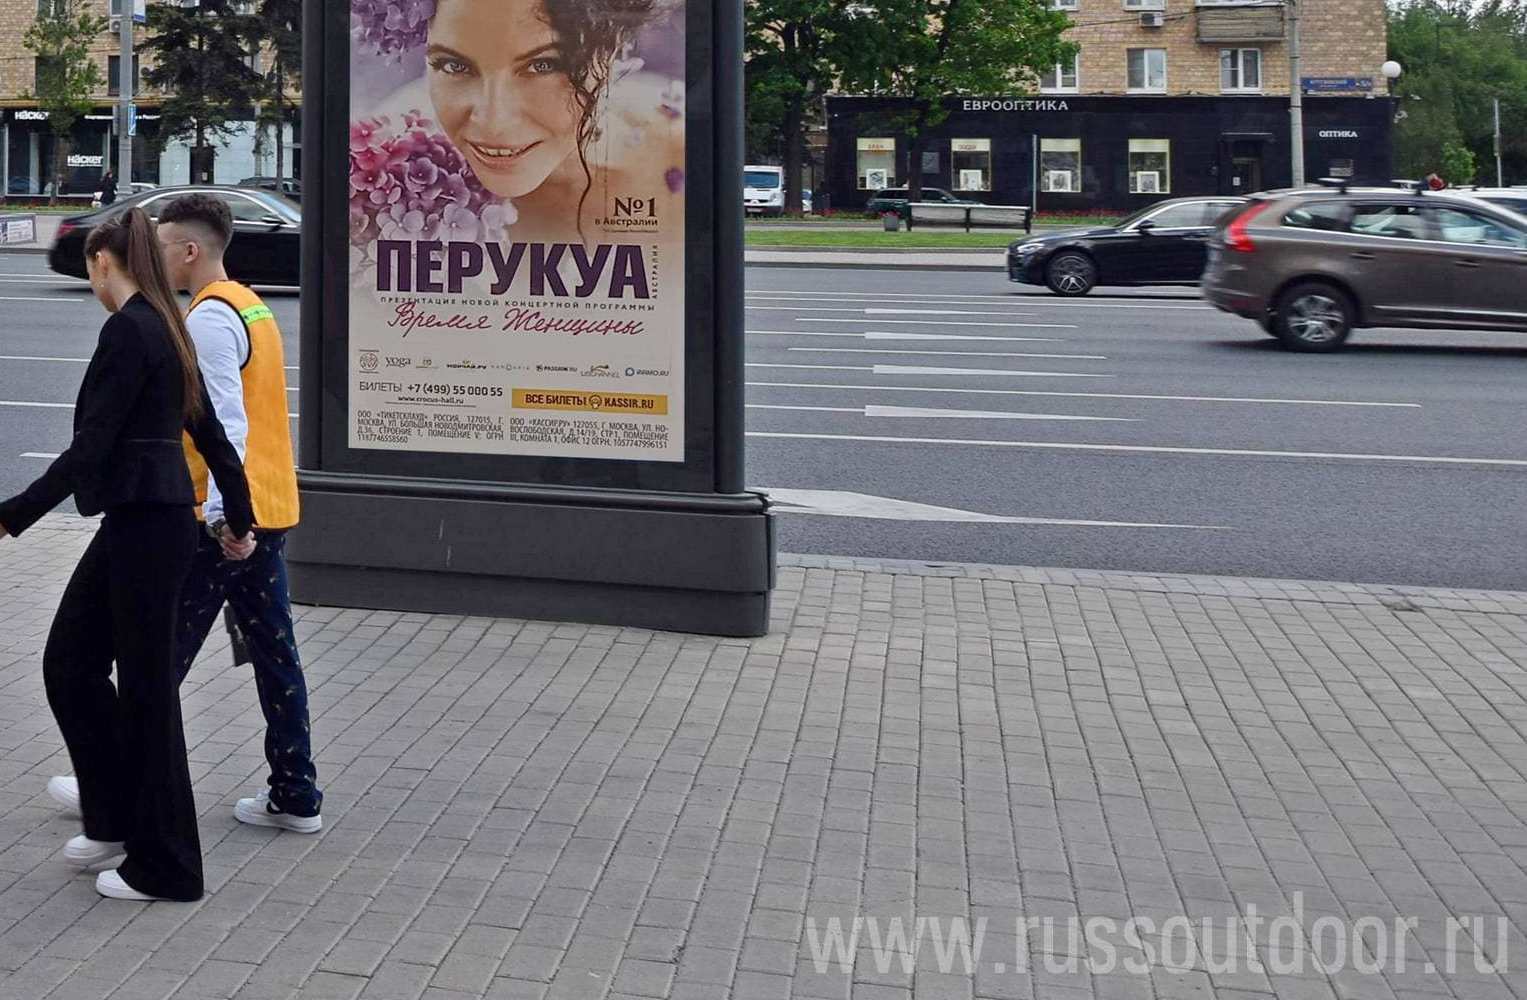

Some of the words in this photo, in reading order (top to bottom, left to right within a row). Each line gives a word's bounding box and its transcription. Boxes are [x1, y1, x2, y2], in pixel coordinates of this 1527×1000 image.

[963, 100, 1069, 111] ЕВРООПТИКА
[1319, 130, 1358, 138] ОПТИКА
[603, 217, 658, 227] Австралии
[376, 240, 650, 299] ПЕРУКУА
[380, 296, 456, 305] ПРЕЗЕНТАЦИЯ
[462, 298, 499, 306] НОВОЙ
[505, 300, 579, 308] КОНЦЕРТНОЙ
[585, 303, 655, 311] ПРОГРАММЫ
[387, 302, 492, 337] Время
[502, 308, 645, 336] Женщины
[385, 356, 411, 367] yoga
[359, 381, 403, 393] БИЛЕТЫ
[407, 384, 421, 392] +7
[423, 383, 451, 395] (499)
[453, 385, 466, 395] 55
[467, 386, 488, 396] 000
[490, 387, 503, 397] 55
[398, 396, 464, 404] www.crocus-hall.ru
[525, 394, 544, 404] ВСЕ
[546, 394, 587, 406] БИЛЕТЫ
[604, 397, 654, 409] KASSIR.RU
[357, 410, 371, 418] ООО
[400, 420, 433, 428] БОЛЬШАЯ
[378, 427, 412, 436] СТРОЕНИЕ
[428, 429, 471, 438] ПОМЕЩЕНИЕ
[624, 431, 669, 441] ПОМЕЩЕНИЕ
[520, 434, 552, 443] КОМНАТА
[582, 437, 590, 445] 12
